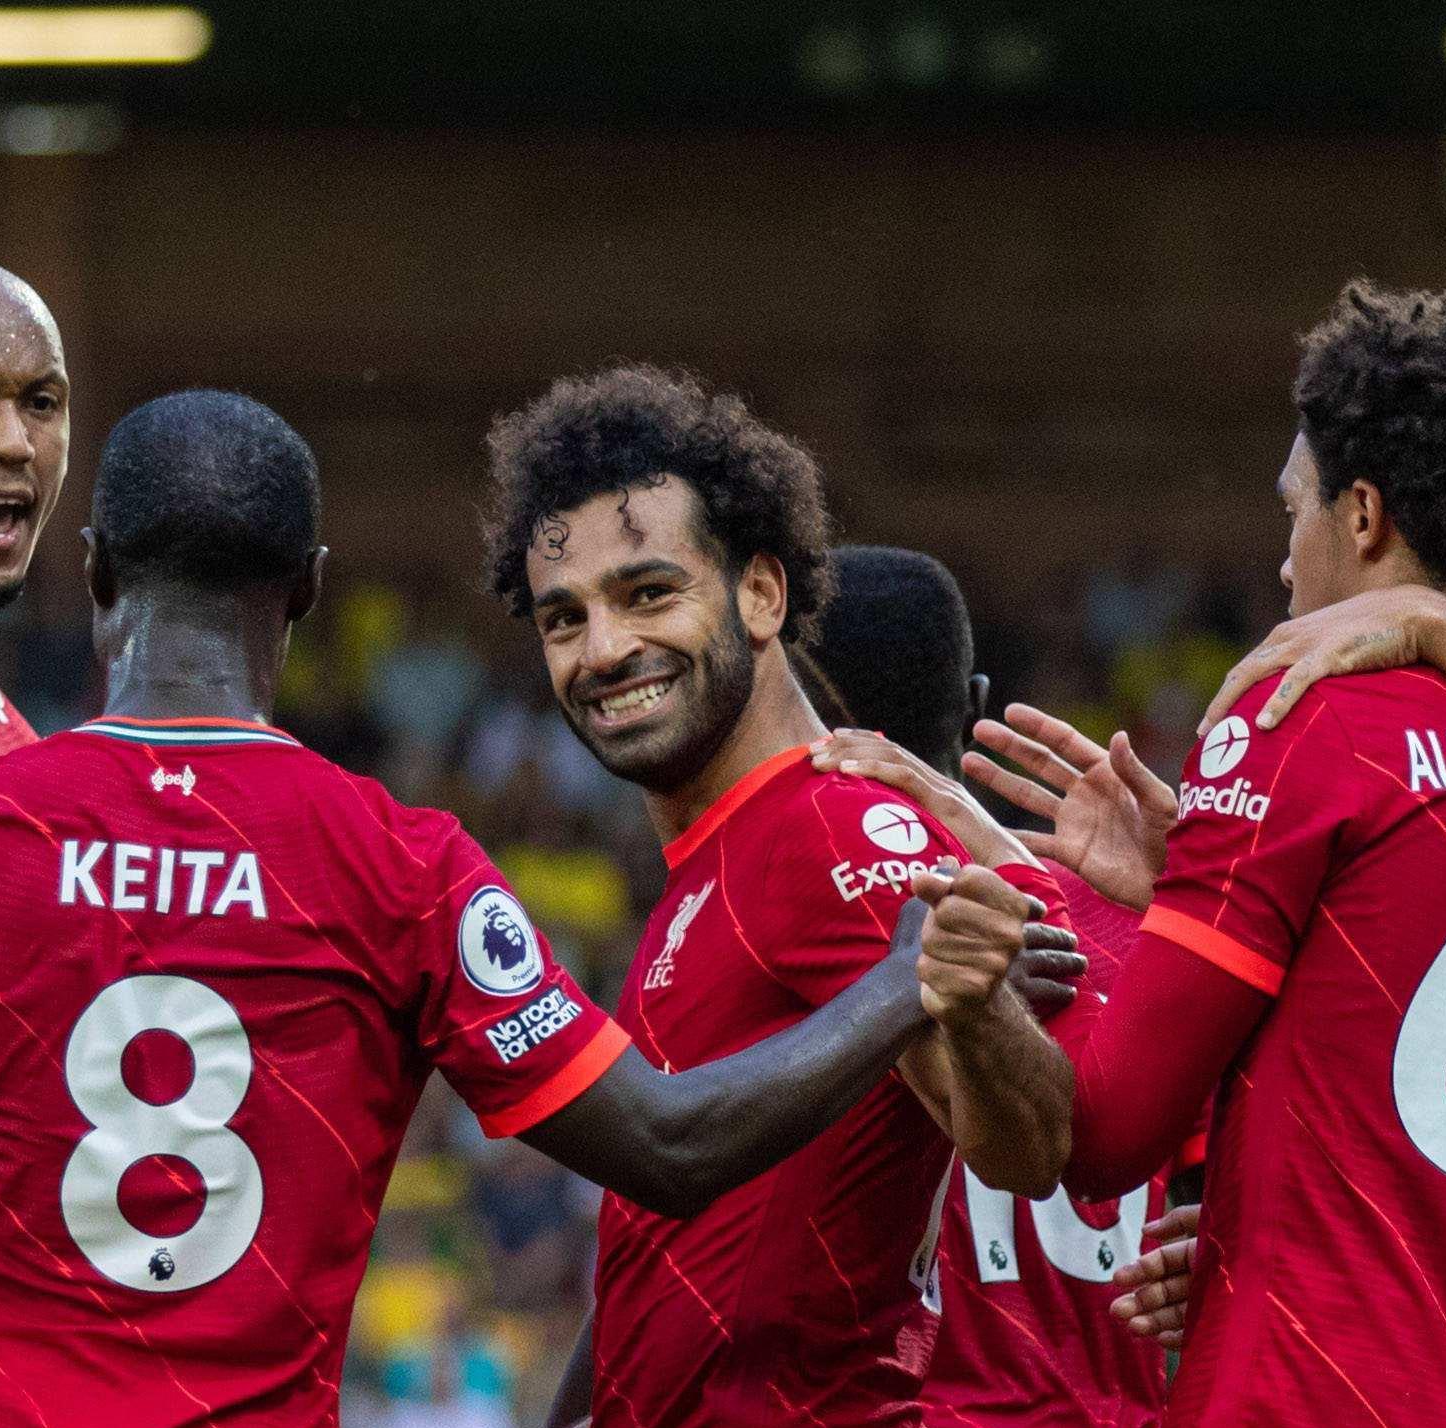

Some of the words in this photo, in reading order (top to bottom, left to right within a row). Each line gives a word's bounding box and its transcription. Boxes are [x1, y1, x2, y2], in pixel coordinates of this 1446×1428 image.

[60, 841, 268, 920] KEITA
[485, 1019, 523, 1048] No
[59, 974, 264, 1294] 8
